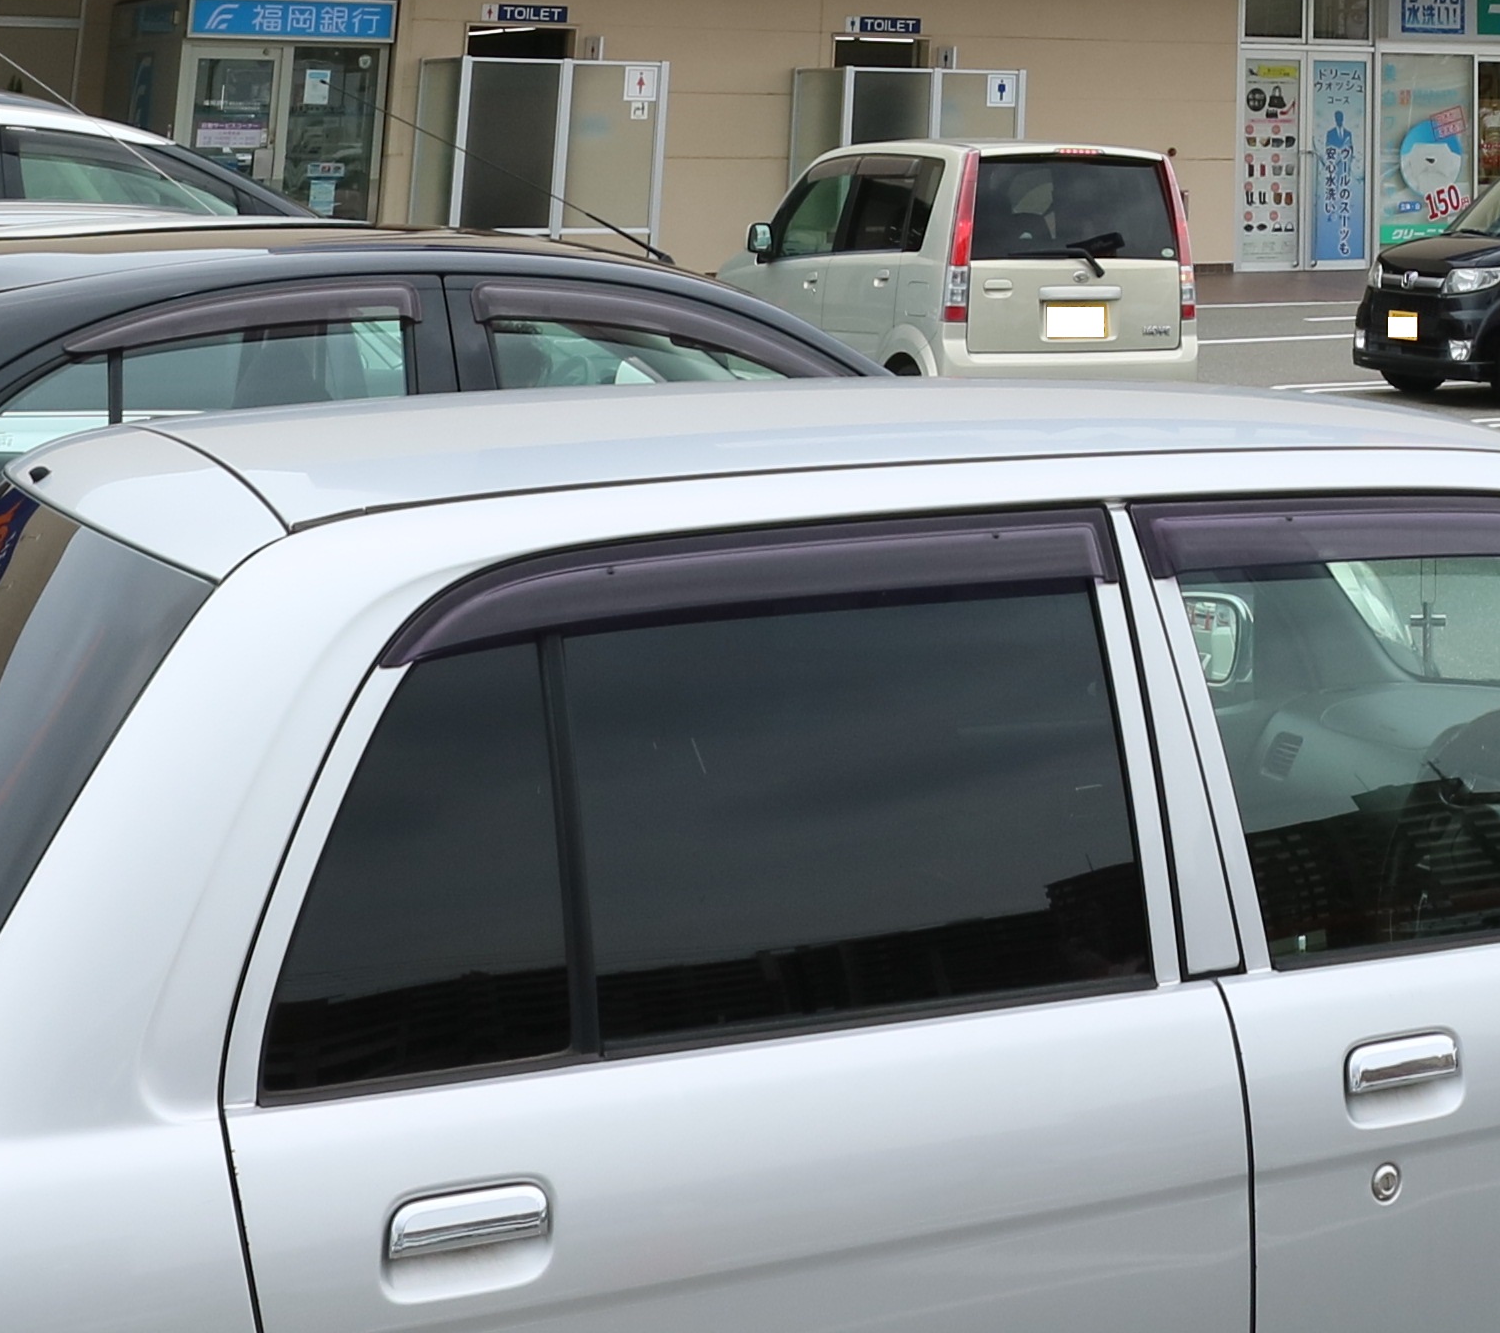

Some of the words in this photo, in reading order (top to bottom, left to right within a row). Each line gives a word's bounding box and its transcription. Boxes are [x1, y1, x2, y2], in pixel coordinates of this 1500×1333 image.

[252, 4, 381, 34] 福岡銀行
[503, 7, 562, 21] TOILET
[864, 19, 916, 32] TOILET
[1318, 68, 1362, 81] ドリーム
[1314, 81, 1364, 93] ウォッシュ
[1327, 97, 1350, 105] コース
